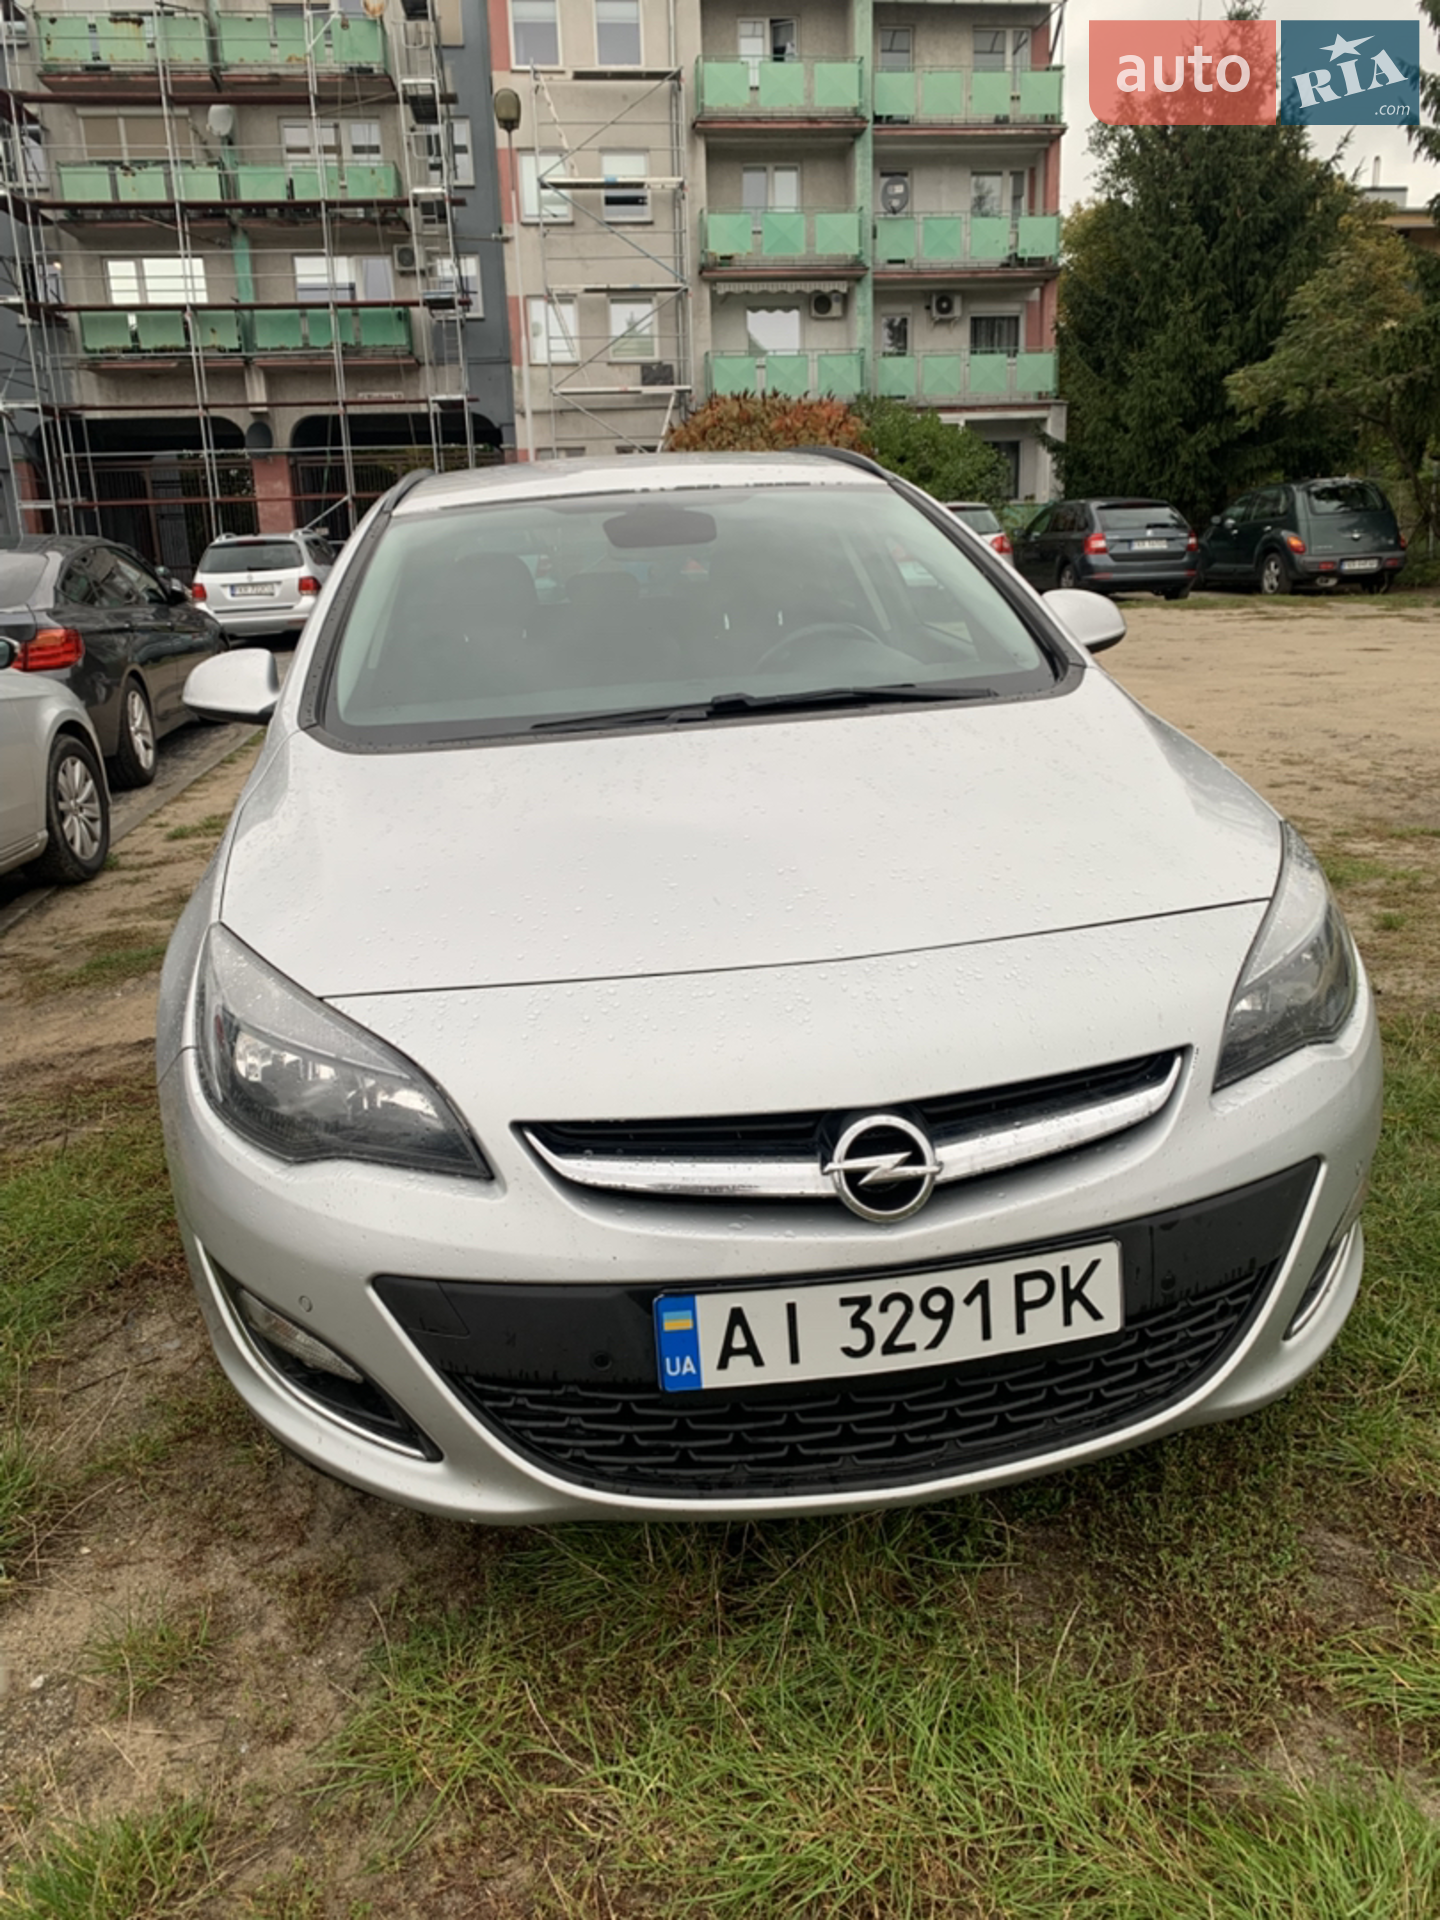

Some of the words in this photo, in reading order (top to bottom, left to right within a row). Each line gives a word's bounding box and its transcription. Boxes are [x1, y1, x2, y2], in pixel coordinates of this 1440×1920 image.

[716, 1301, 801, 1371] AI
[839, 1278, 993, 1359] 3291
[1013, 1258, 1105, 1336] PK
[665, 1356, 698, 1378] UA
